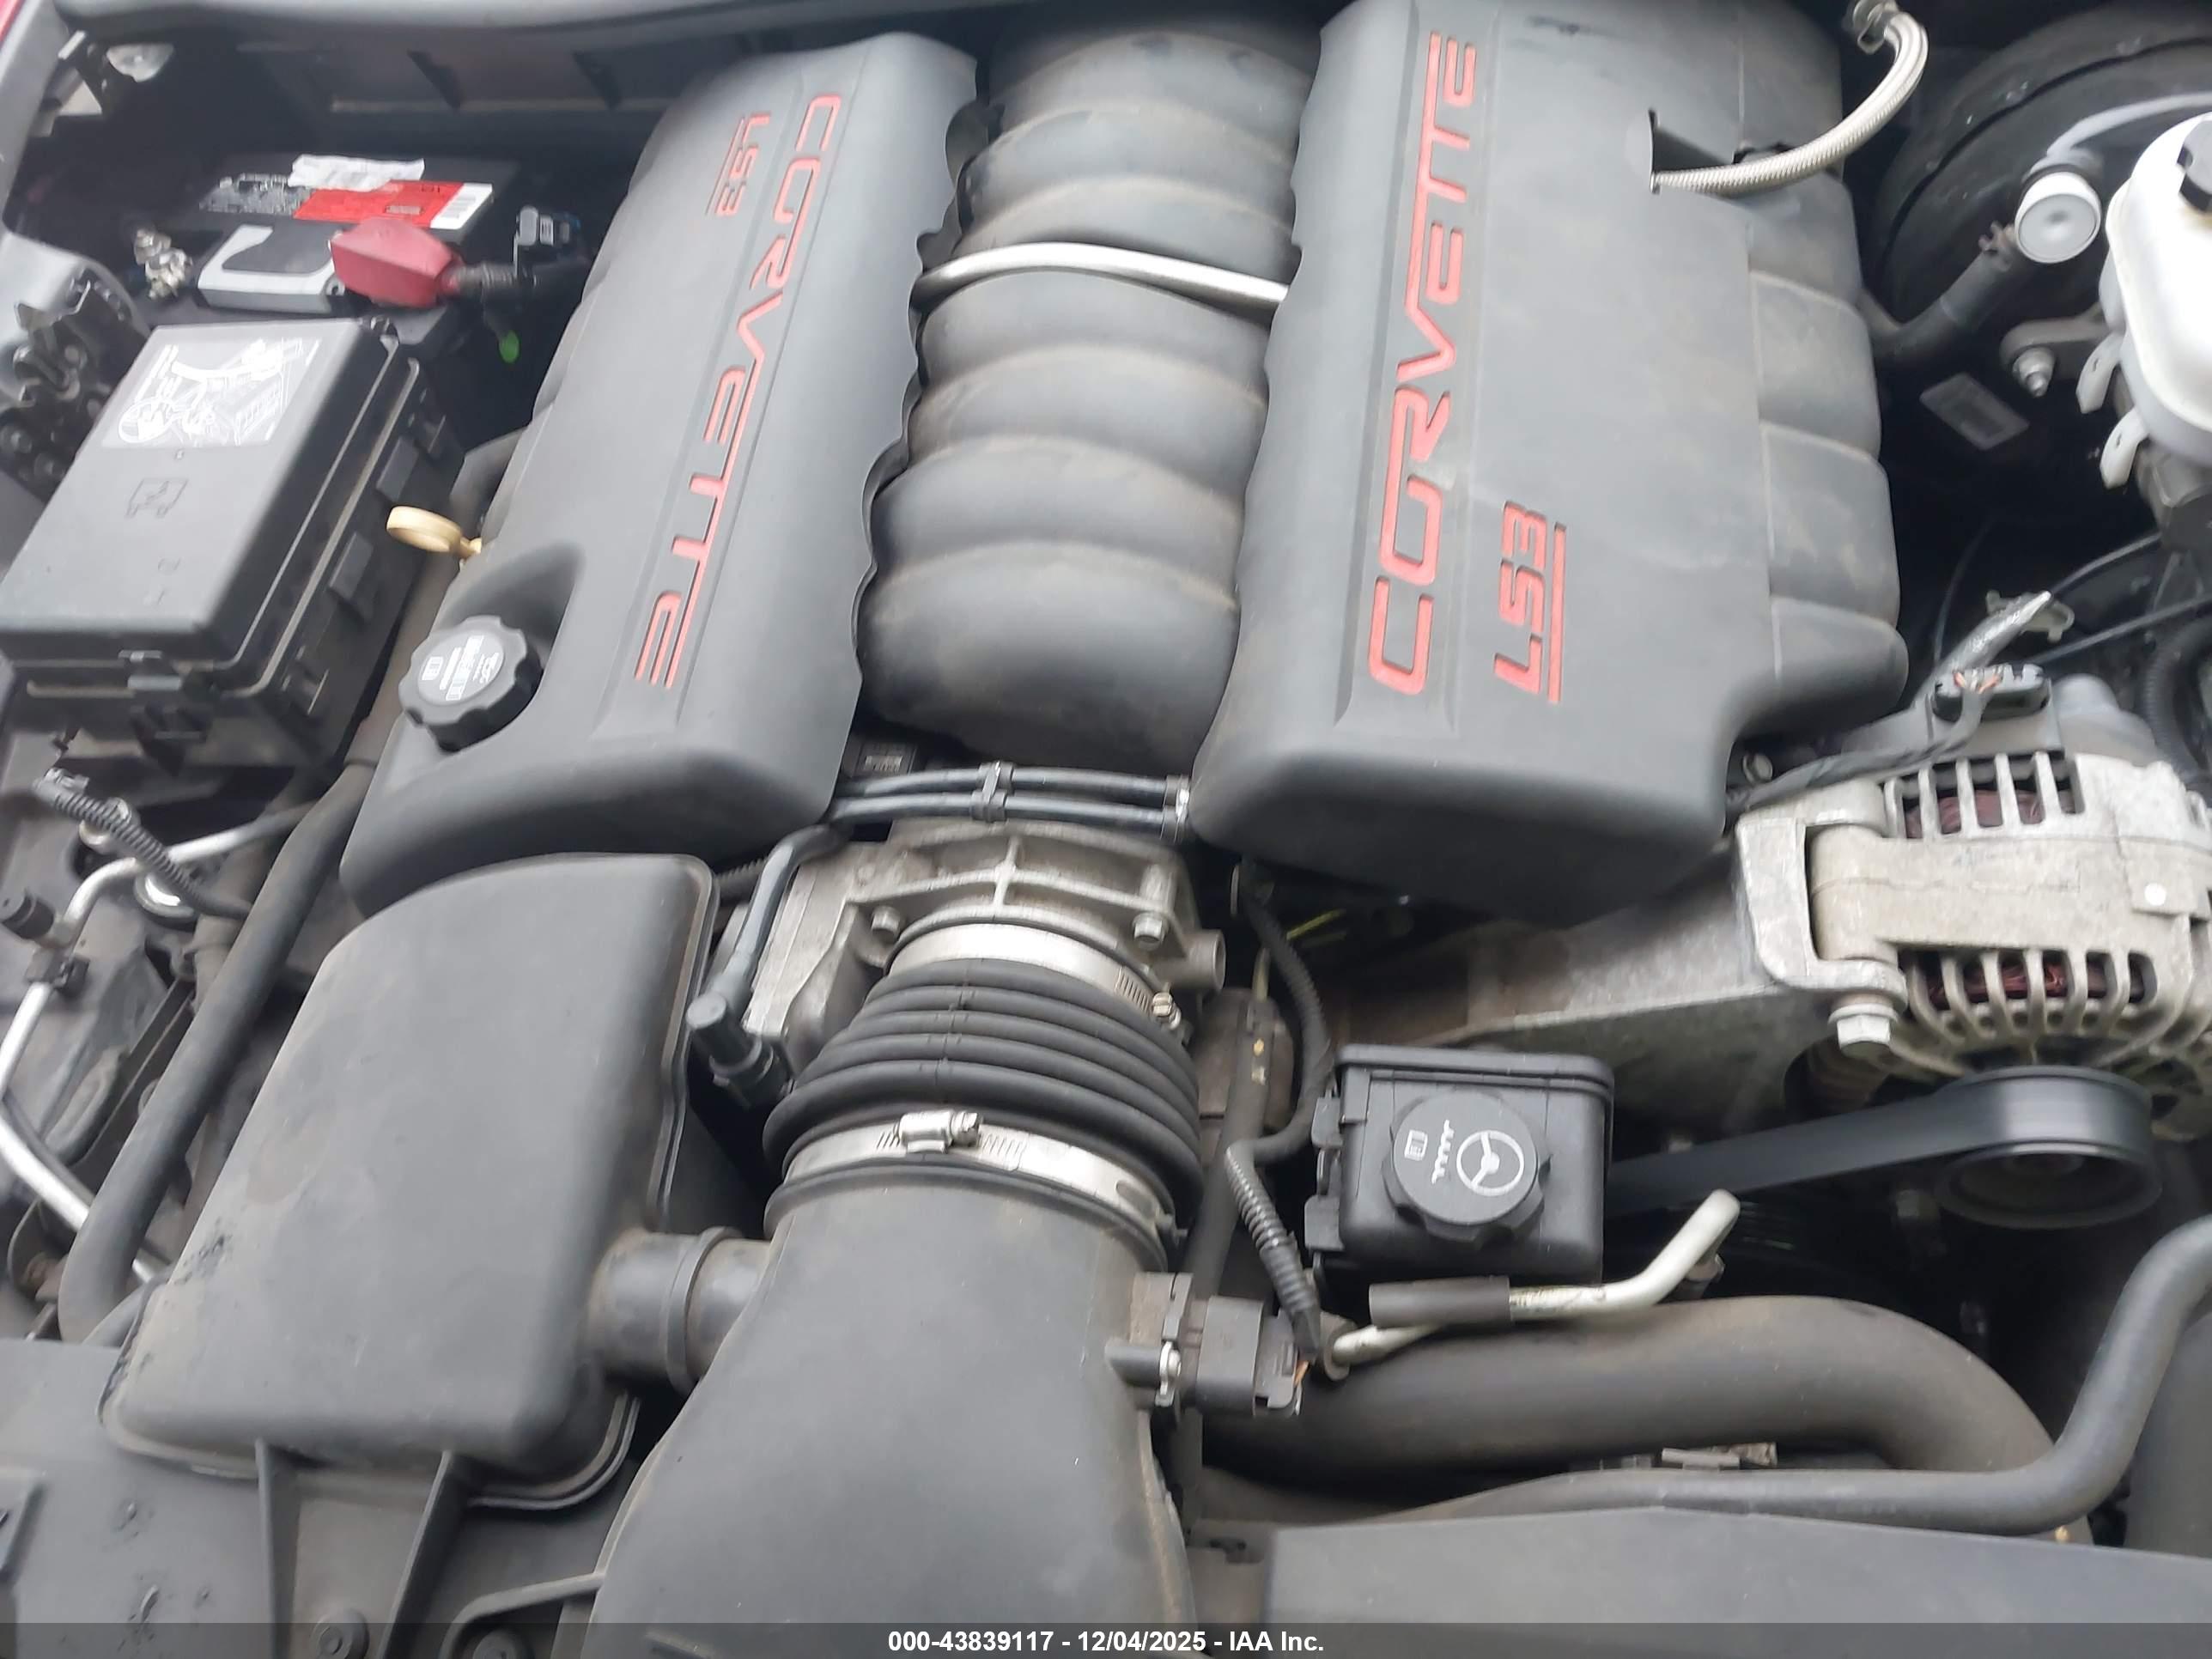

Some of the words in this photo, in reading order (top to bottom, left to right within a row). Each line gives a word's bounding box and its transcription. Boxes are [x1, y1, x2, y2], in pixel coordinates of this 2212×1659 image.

[714, 112, 771, 216] LS3
[635, 94, 842, 688] CORVETTE
[1367, 32, 1477, 696] CORVETTE
[1494, 501, 1547, 695] LS3
